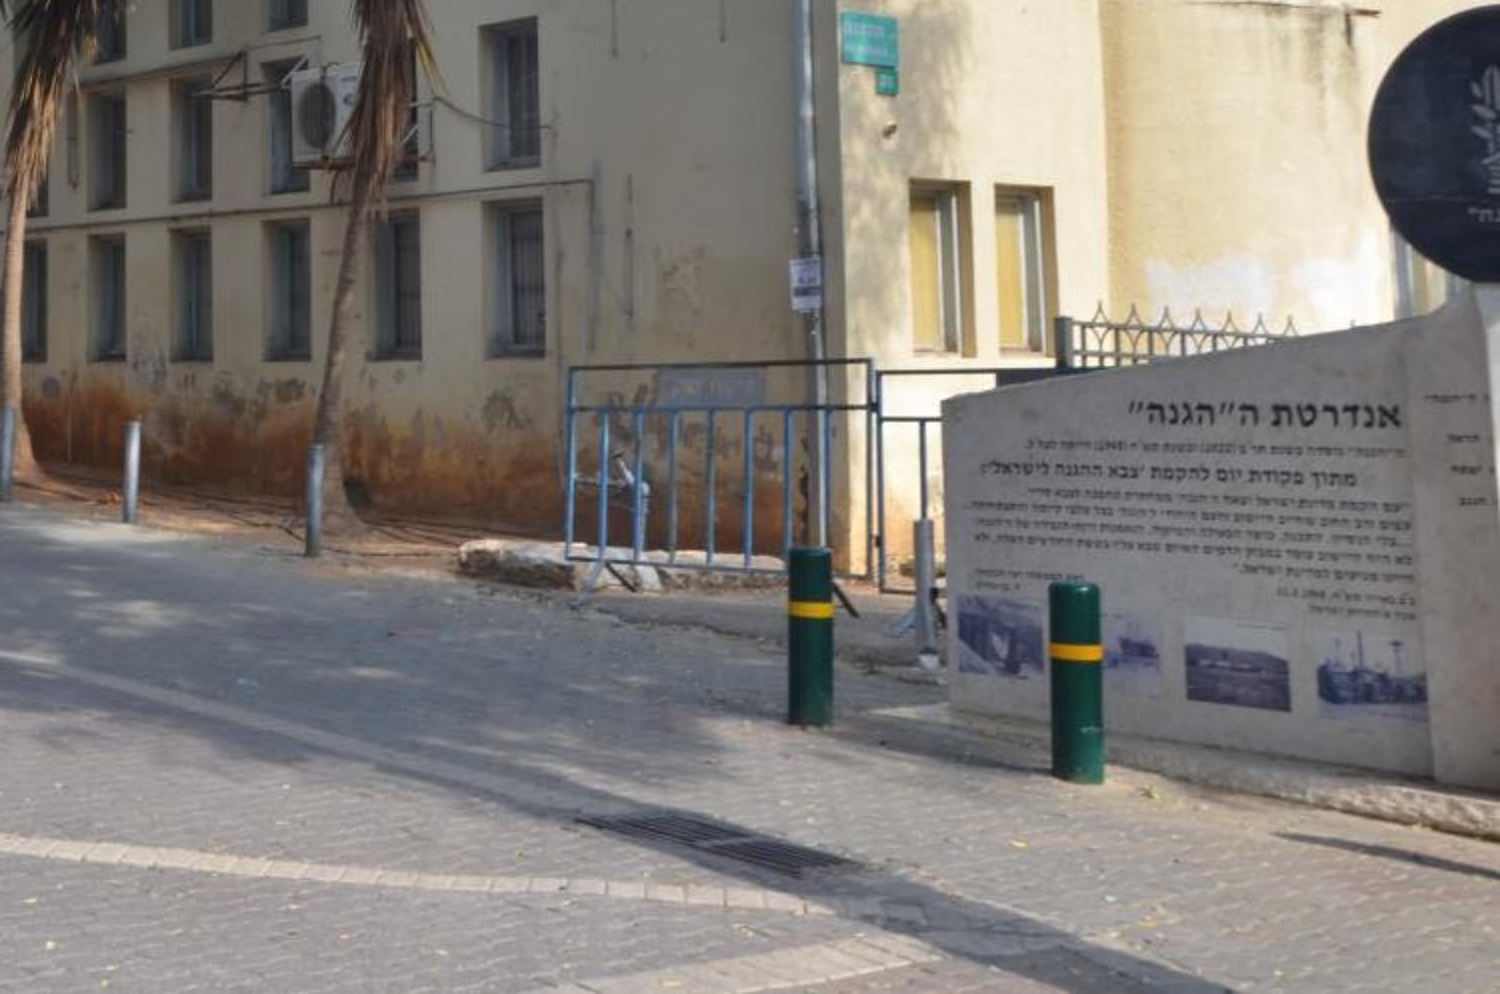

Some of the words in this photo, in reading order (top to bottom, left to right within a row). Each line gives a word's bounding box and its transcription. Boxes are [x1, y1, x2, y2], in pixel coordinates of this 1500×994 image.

[1128, 400, 1260, 427] ה"הגנה"
[1270, 402, 1402, 428] אנדרטת
[1150, 463, 1210, 482] להקמת
[1216, 467, 1243, 483] יום
[1248, 468, 1304, 486] פקודת
[1310, 471, 1357, 490] מתוך
